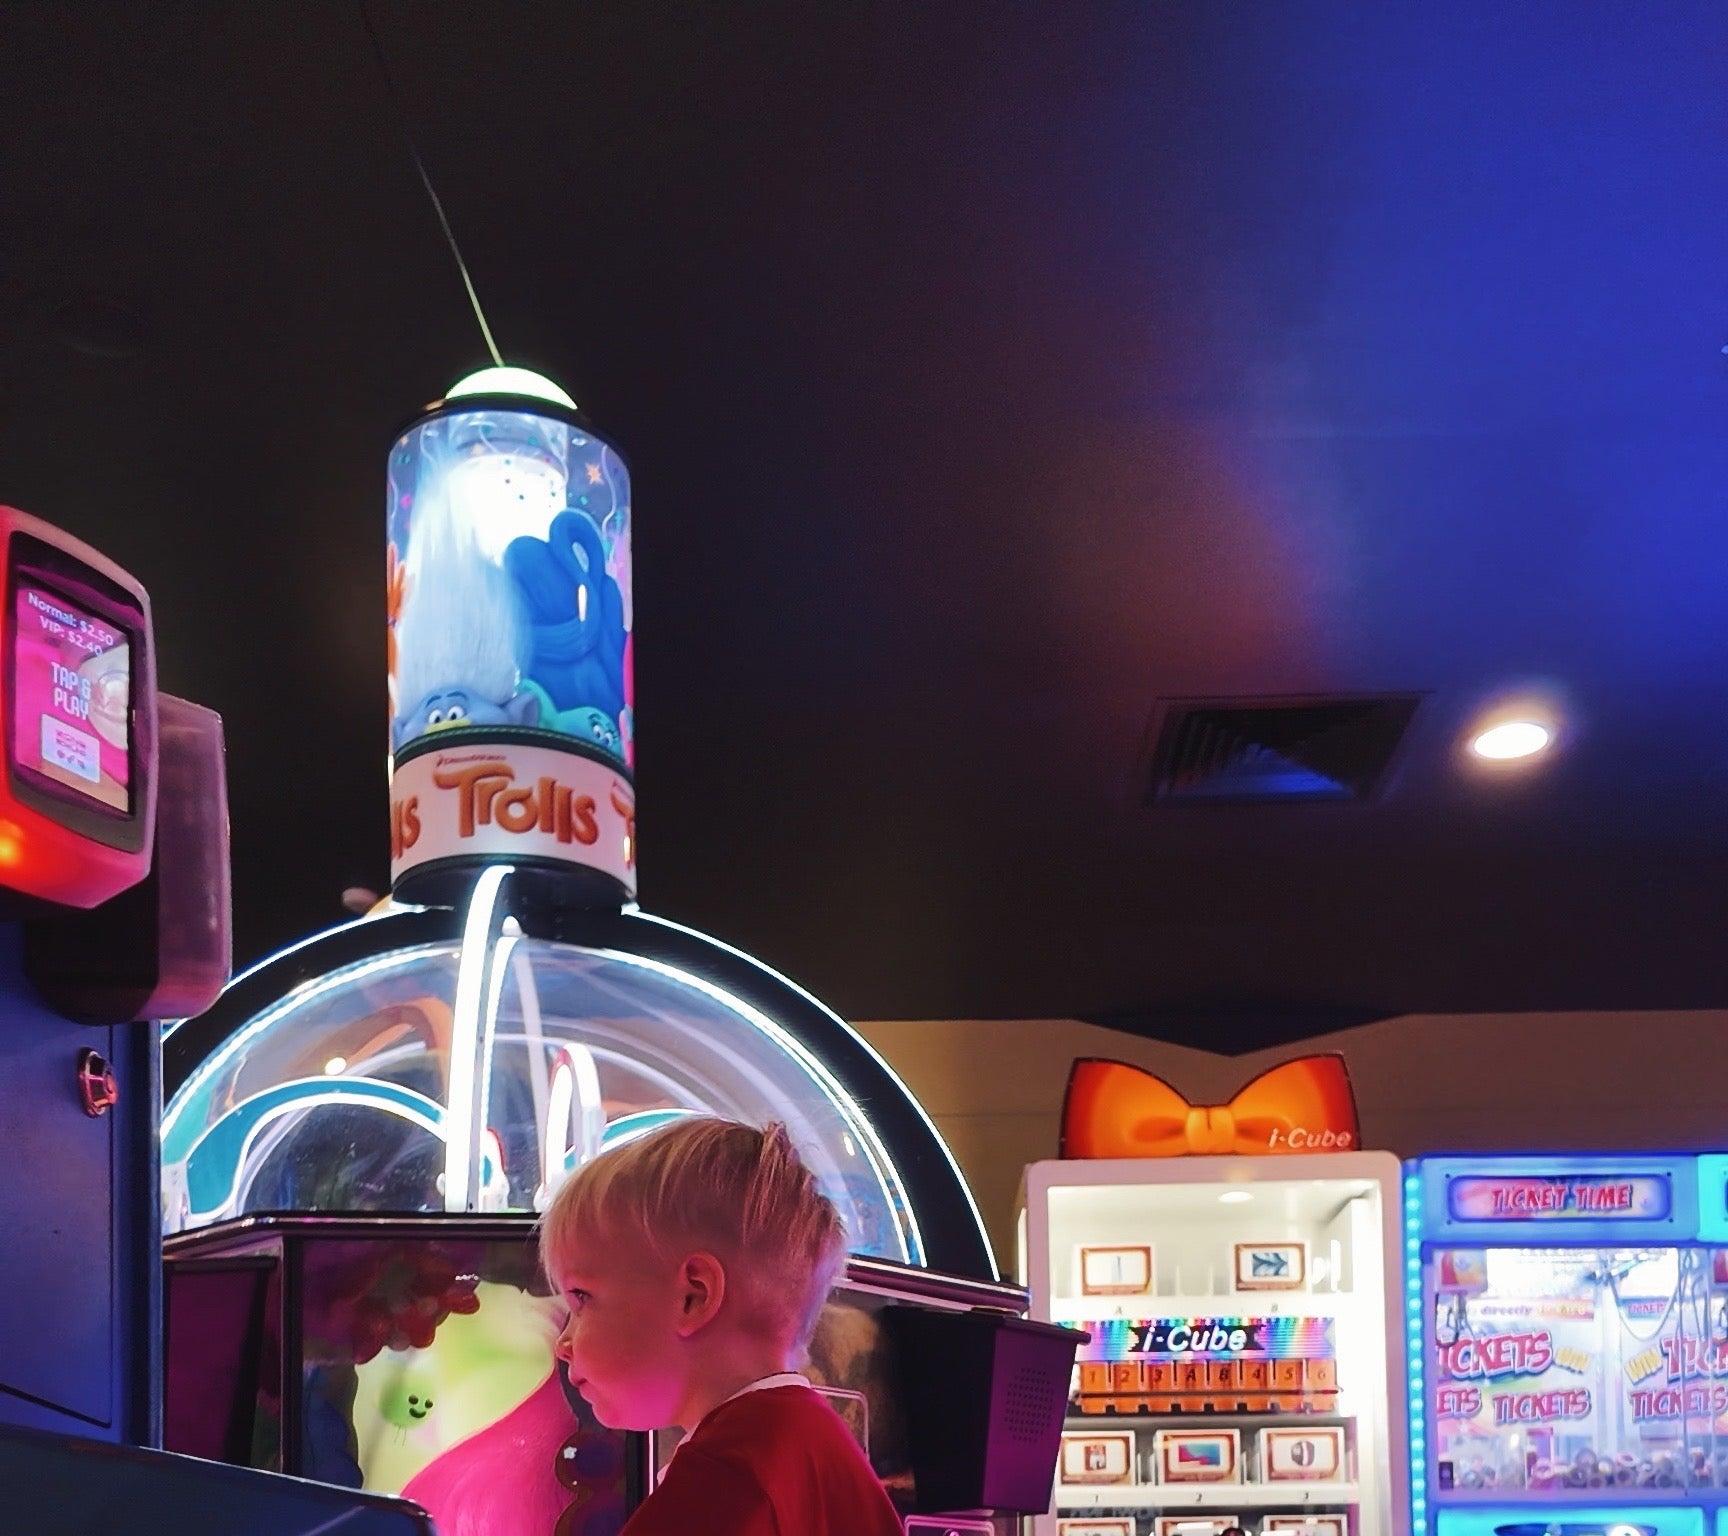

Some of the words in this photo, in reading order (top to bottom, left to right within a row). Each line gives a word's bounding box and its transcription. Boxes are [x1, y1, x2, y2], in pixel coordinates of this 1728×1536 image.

[28, 591, 77, 628] Normal:
[80, 620, 114, 646] $2.50
[40, 615, 65, 637] VIP:
[68, 630, 103, 656] $2.40
[51, 661, 79, 691] TAP
[81, 678, 91, 700] &
[54, 687, 88, 720] PLAY
[432, 762, 599, 845] Trolls
[1268, 1127, 1352, 1149] i-Cube
[1491, 1186, 1569, 1211] TICKET
[1574, 1184, 1634, 1208] TIME
[1142, 1325, 1248, 1352] i-Cube
[1120, 1369, 1130, 1382] 2
[1185, 1368, 1196, 1381] A
[1252, 1368, 1261, 1379] 4
[1284, 1367, 1294, 1380] 5
[1492, 1389, 1591, 1424] TICKETS
